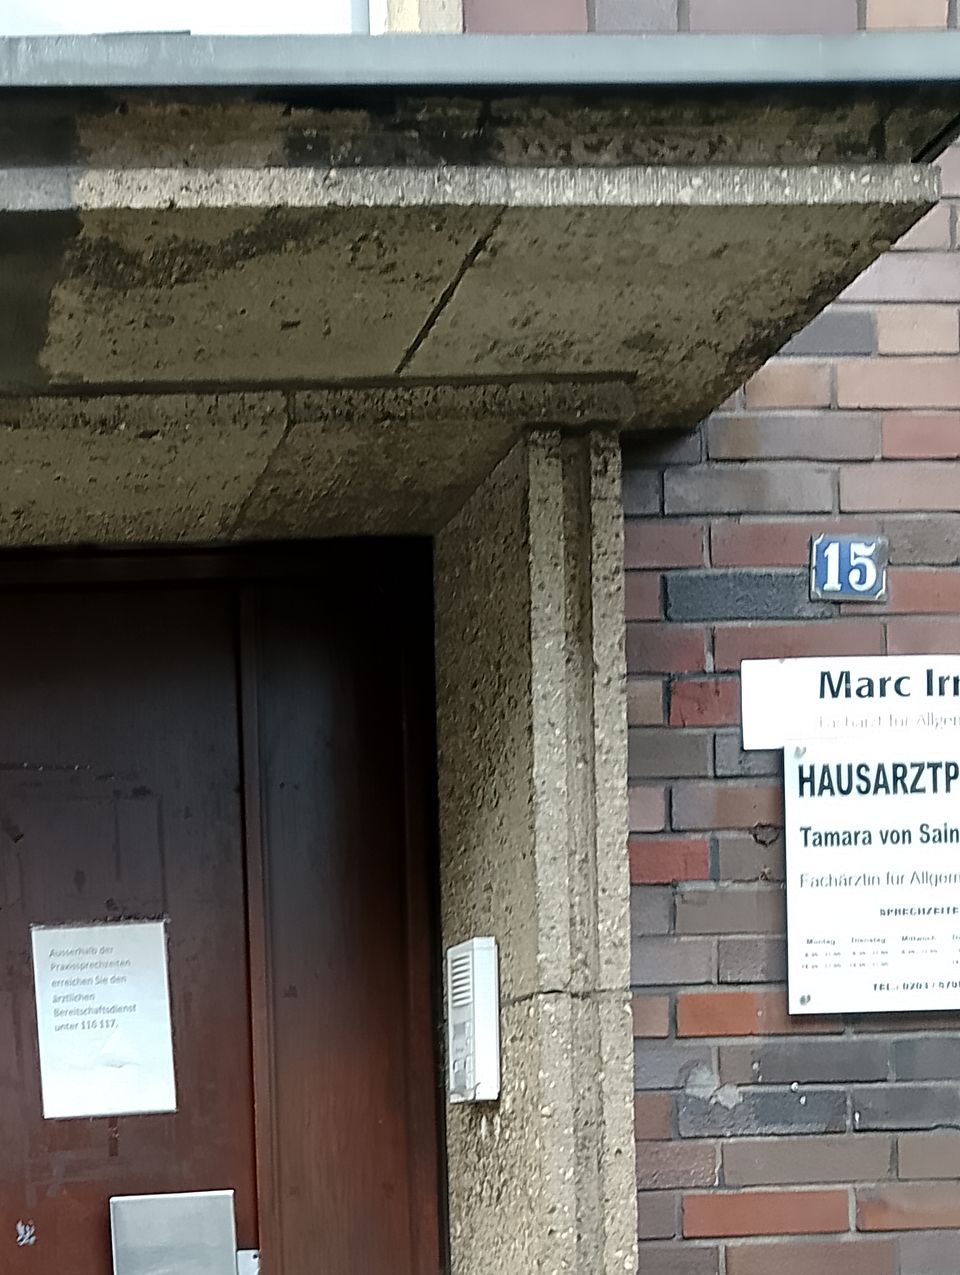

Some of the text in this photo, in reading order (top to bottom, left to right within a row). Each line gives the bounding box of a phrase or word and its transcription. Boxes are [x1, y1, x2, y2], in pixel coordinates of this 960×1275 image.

[821, 541, 879, 593] 15
[818, 669, 911, 699] Marc
[797, 761, 960, 798] HAUSARZTP
[799, 825, 873, 848] Tamara
[879, 828, 913, 846] von
[54, 1022, 79, 1032] unter
